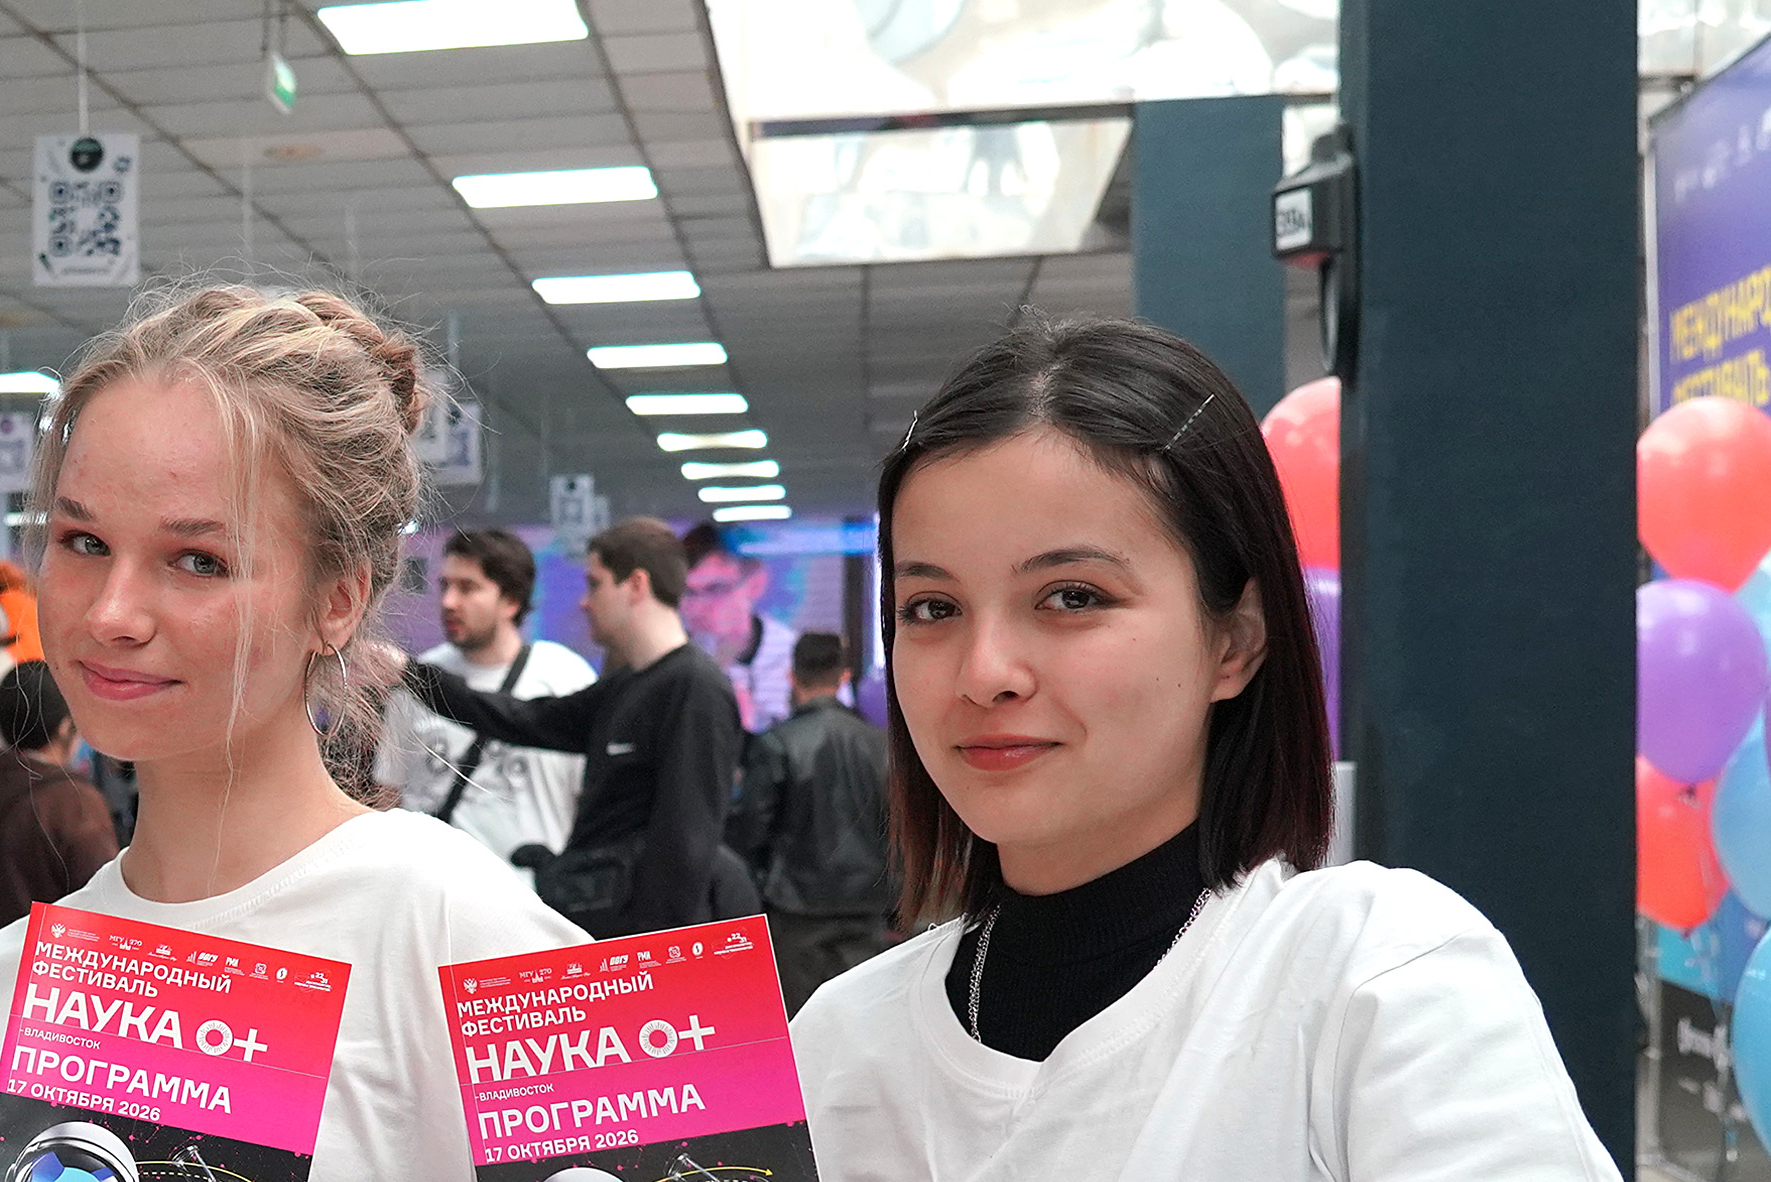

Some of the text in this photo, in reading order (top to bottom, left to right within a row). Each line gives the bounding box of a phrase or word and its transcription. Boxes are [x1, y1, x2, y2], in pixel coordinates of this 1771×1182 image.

[31, 960, 158, 998] ФЕСТИВАЛЬ
[35, 940, 233, 994] МЕЖДУНАРОДНЫЙ
[22, 983, 184, 1049] НАУКА
[457, 971, 654, 1018] МЕЖДУНАРОДНЫЙ
[461, 1007, 587, 1037] ФЕСТИВАЛЬ
[11, 1044, 233, 1114] ПРОГРАММА
[465, 1026, 632, 1084] НАУКА
[7, 1078, 161, 1121] 17 ОКТЯБРЯ 2026
[478, 1083, 706, 1139] ПРОГРАММА
[484, 1128, 639, 1163] 17 ОКТЯБРЯ 2026
